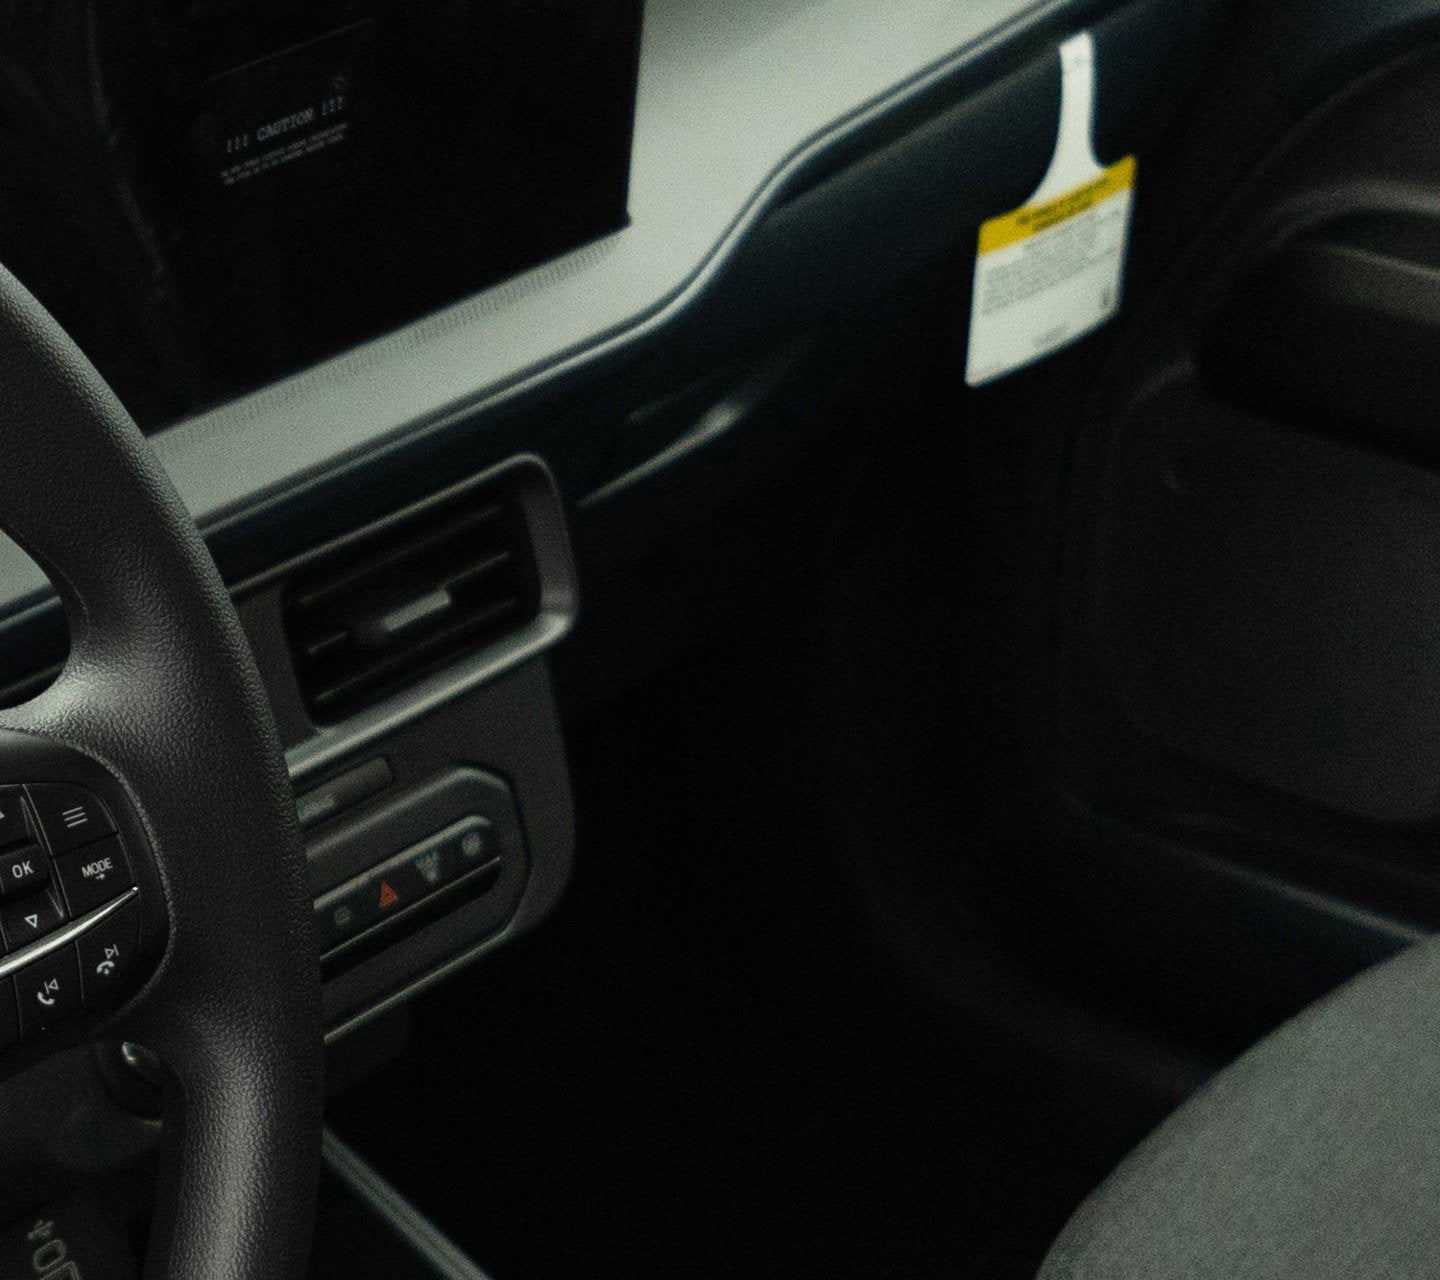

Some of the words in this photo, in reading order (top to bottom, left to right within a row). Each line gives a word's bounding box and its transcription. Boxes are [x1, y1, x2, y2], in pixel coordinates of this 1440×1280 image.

[256, 107, 315, 142] CAUTION
[11, 861, 34, 879] OK
[81, 858, 113, 878] MODE
